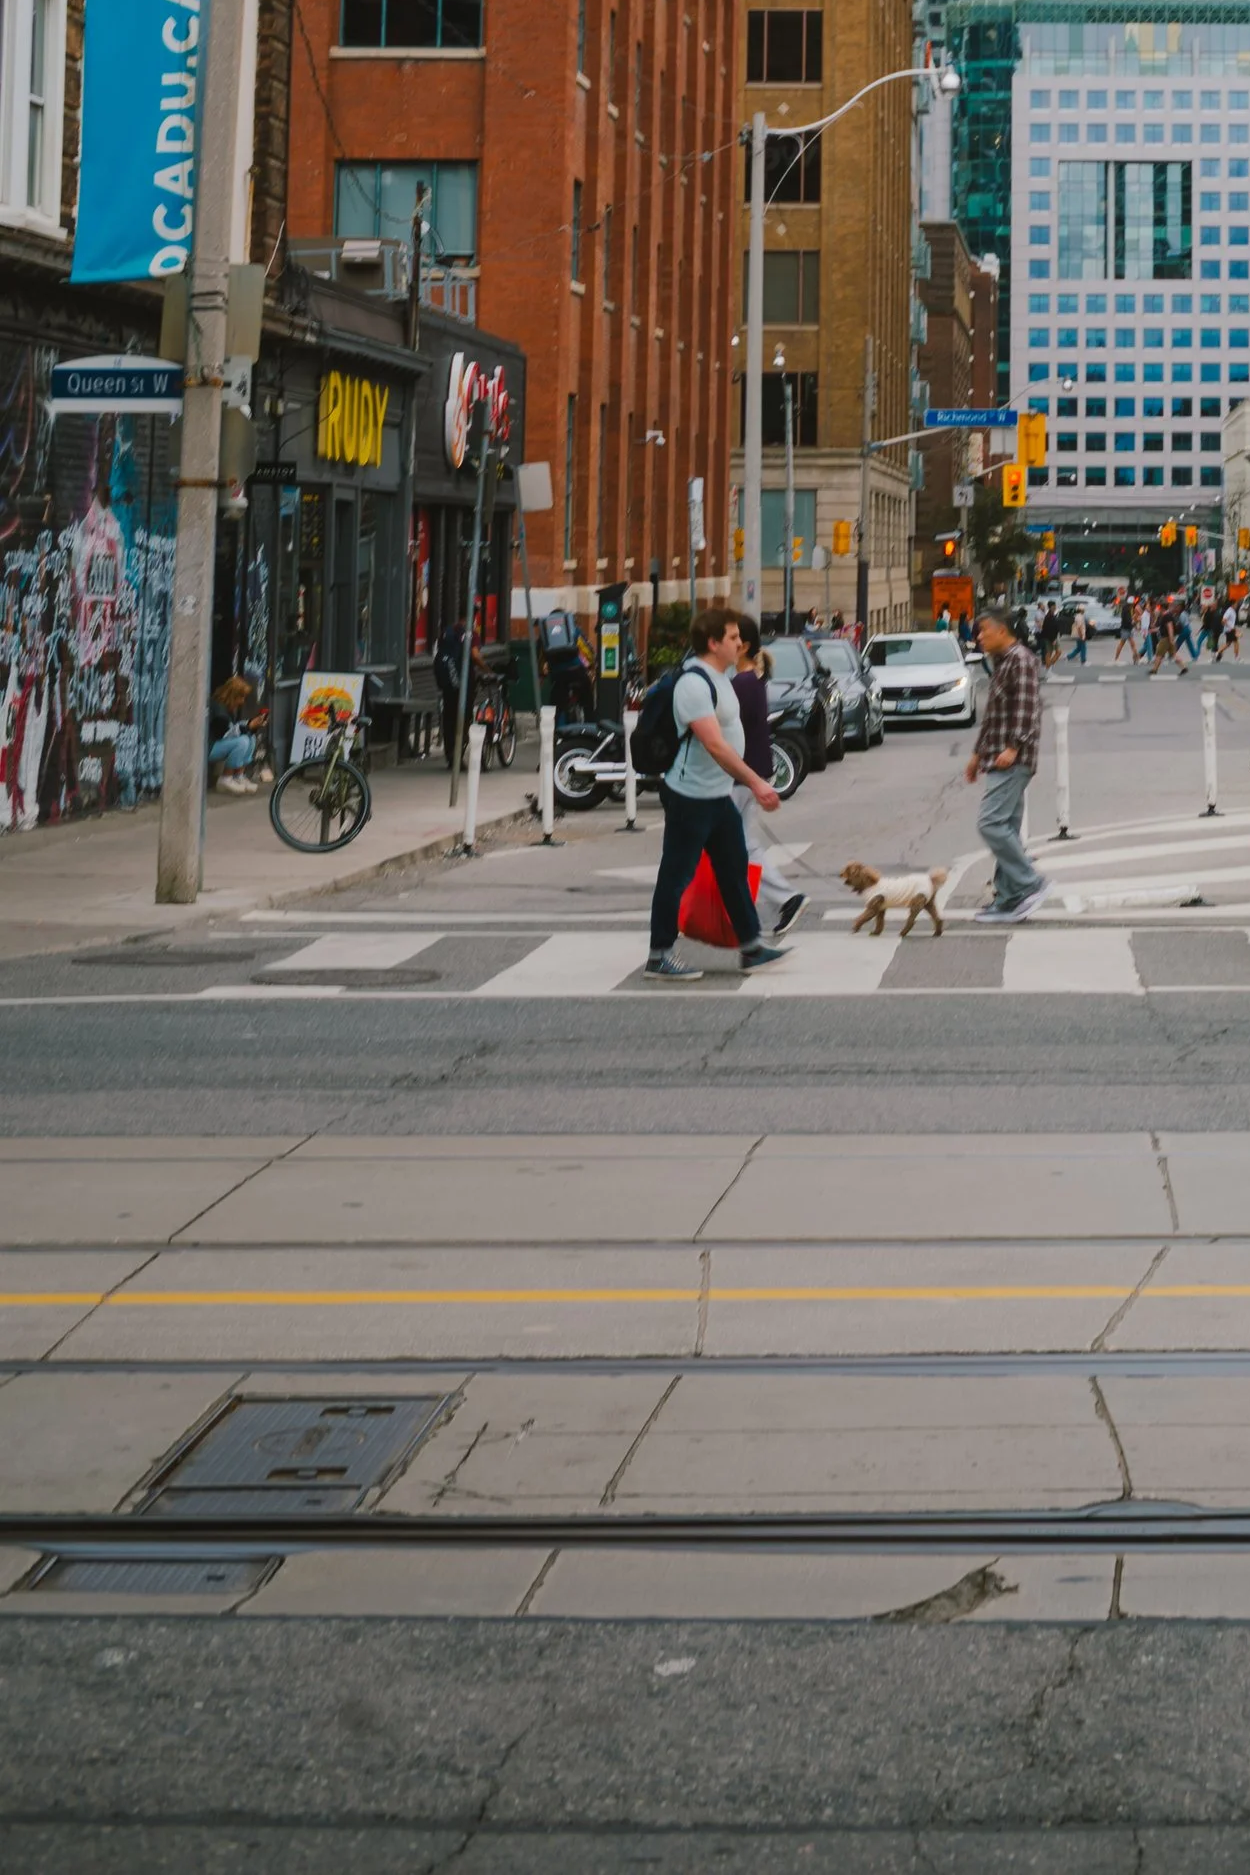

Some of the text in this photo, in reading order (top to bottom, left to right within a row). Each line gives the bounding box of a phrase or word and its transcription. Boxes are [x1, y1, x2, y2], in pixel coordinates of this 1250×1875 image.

[66, 372, 127, 395] Queen
[153, 372, 169, 394] W
[321, 370, 390, 469] RUDY
